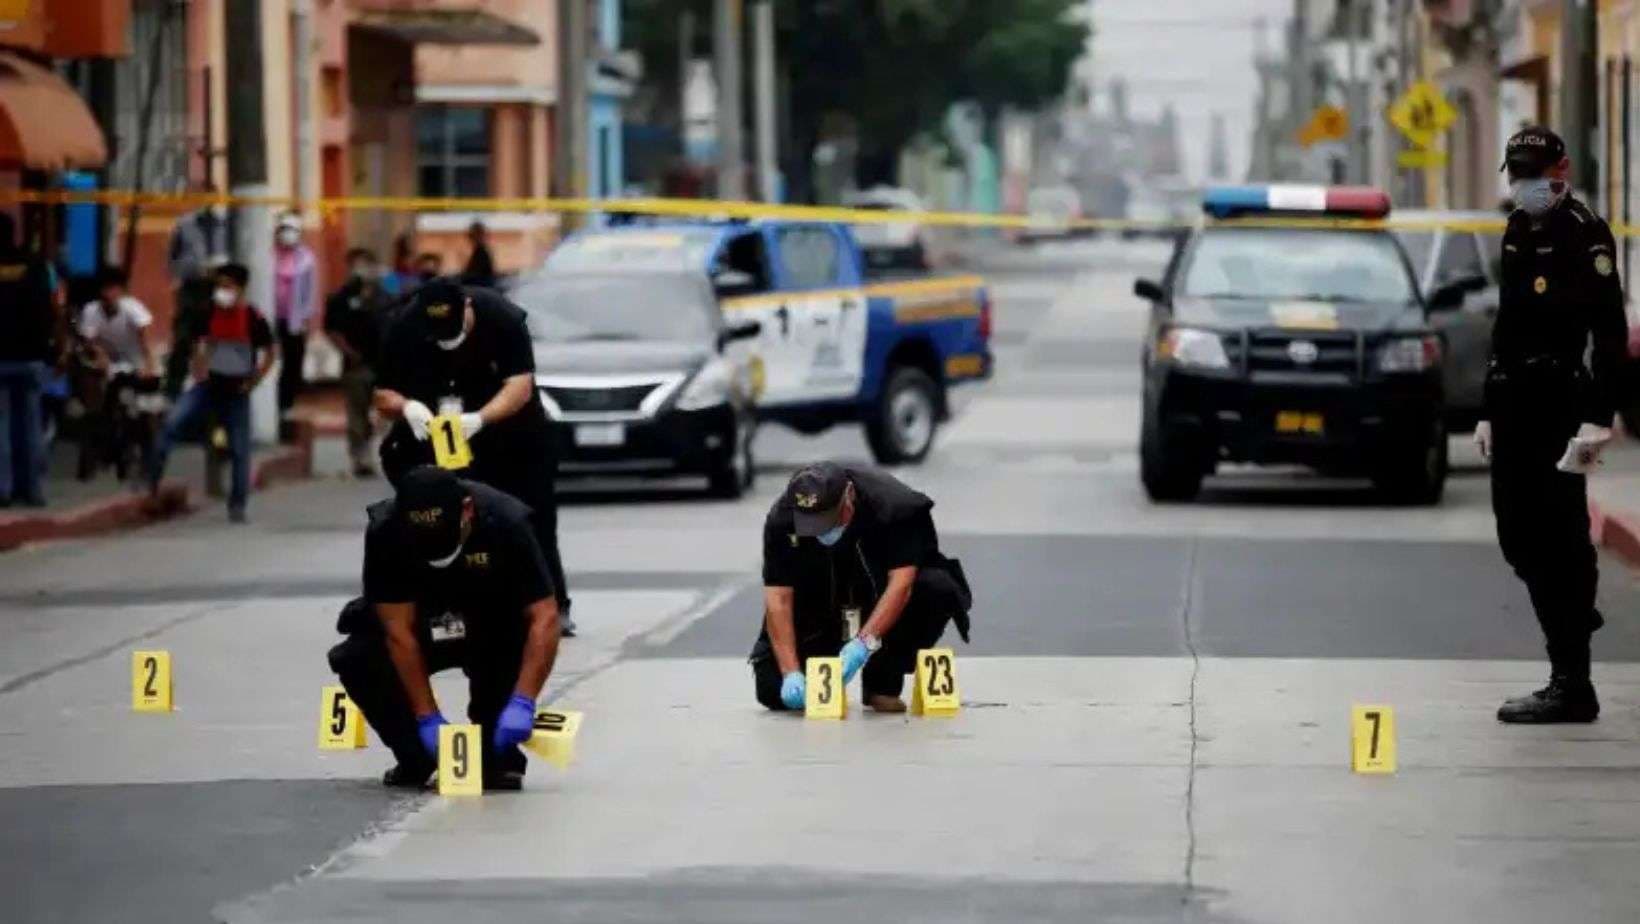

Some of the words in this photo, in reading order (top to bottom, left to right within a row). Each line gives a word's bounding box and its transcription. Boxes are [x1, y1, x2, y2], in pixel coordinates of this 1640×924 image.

[440, 420, 458, 456] 1
[144, 657, 157, 698] 2
[818, 664, 832, 704] 3
[925, 655, 954, 696] 23
[330, 692, 346, 736] 5
[451, 731, 469, 779] 9
[1365, 712, 1381, 760] 7
